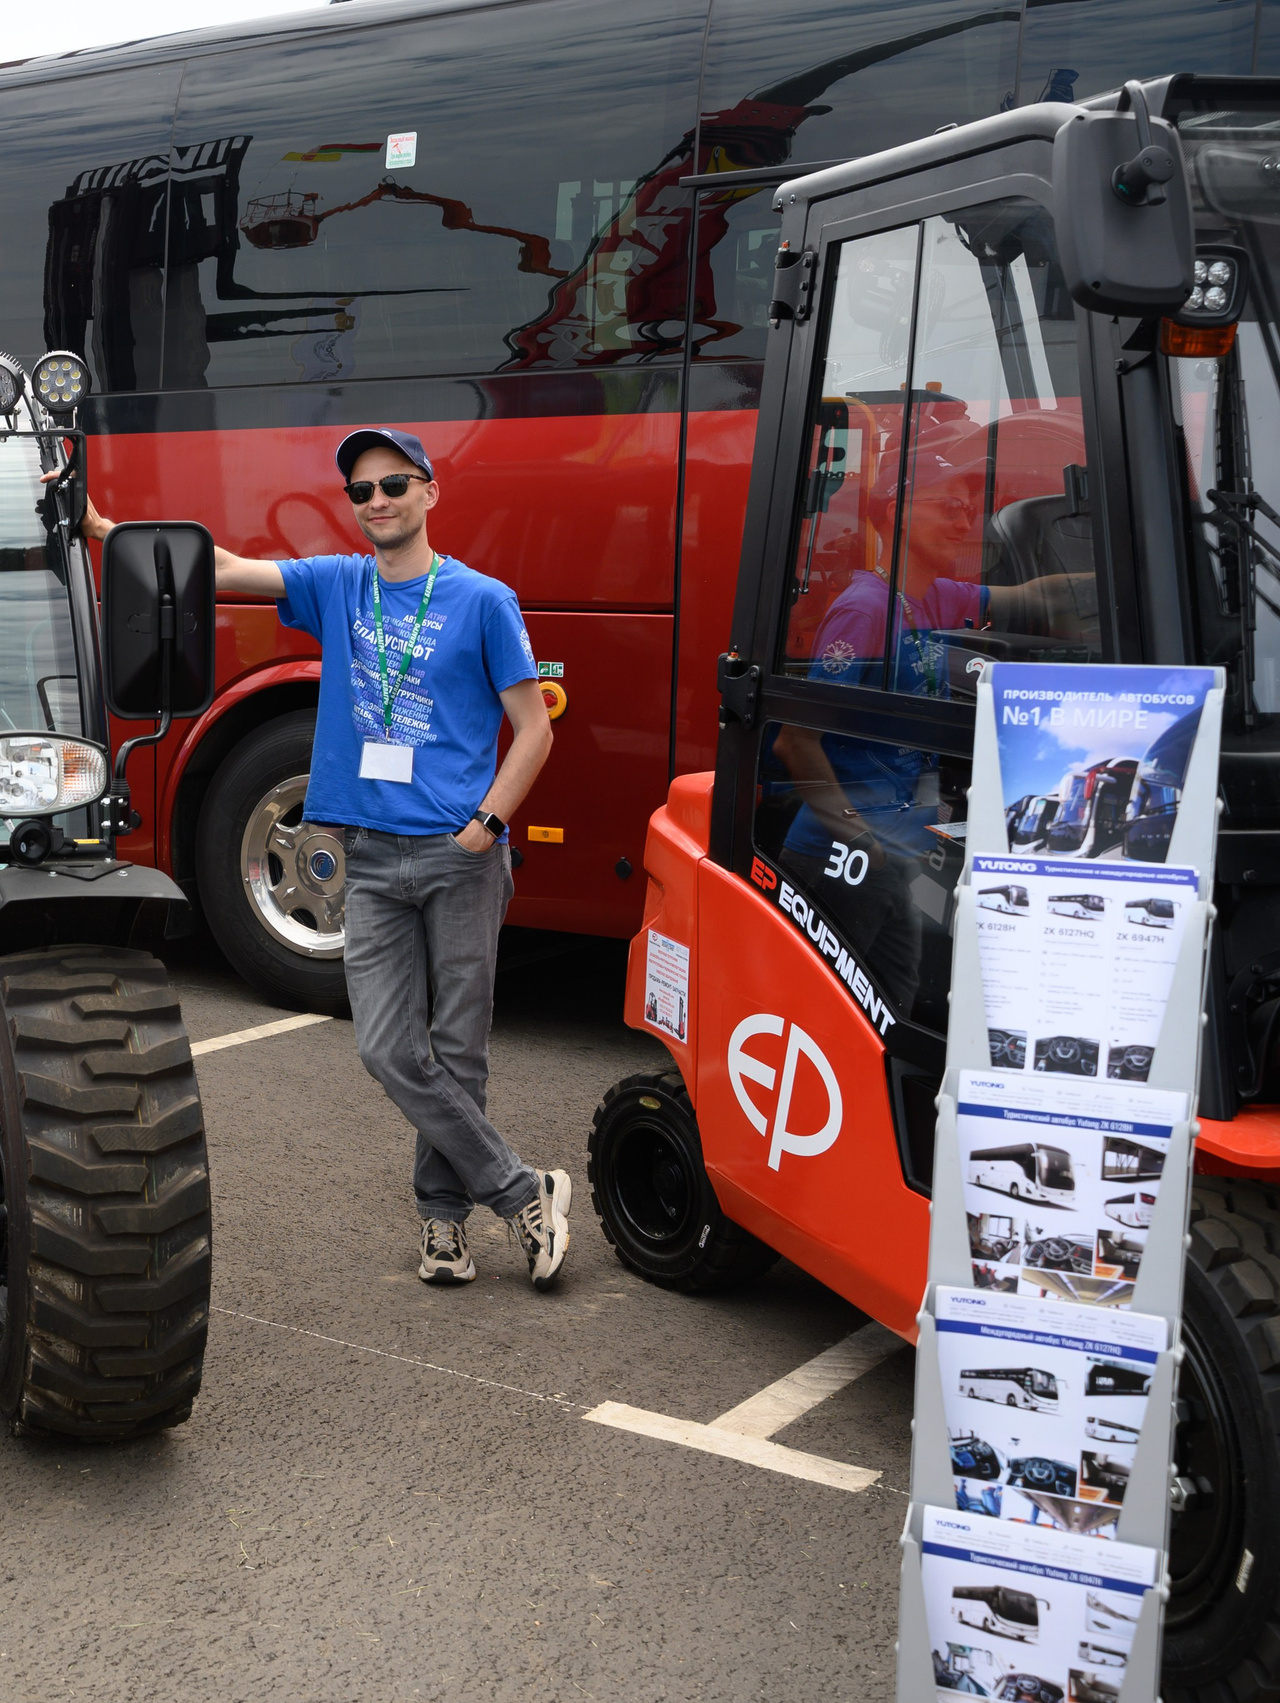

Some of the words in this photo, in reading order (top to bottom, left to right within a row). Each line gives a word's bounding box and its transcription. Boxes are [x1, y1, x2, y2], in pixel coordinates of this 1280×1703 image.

[403, 614, 443, 631] АВТБУСЫ
[387, 686, 434, 707] ПГРУЗЧИКИ
[1003, 689, 1114, 702] ПРОИЗВОДИТЕЛЬ
[1118, 692, 1195, 705] АВТОБУСОВ
[1002, 706, 1041, 726] №1
[1049, 707, 1066, 726] В
[1073, 708, 1149, 730] МИРЕ
[824, 841, 869, 885] 30
[977, 859, 1038, 873] YUTONG
[1043, 927, 1056, 936] ZK
[1058, 928, 1096, 939] 6127HQ
[1116, 932, 1129, 941] ZK
[750, 856, 777, 890] EP
[778, 880, 896, 1036] EQUIPMENT
[970, 1080, 1005, 1089] YUTONG
[950, 1296, 987, 1306] YUTONG
[935, 1519, 971, 1531] YUTONG
